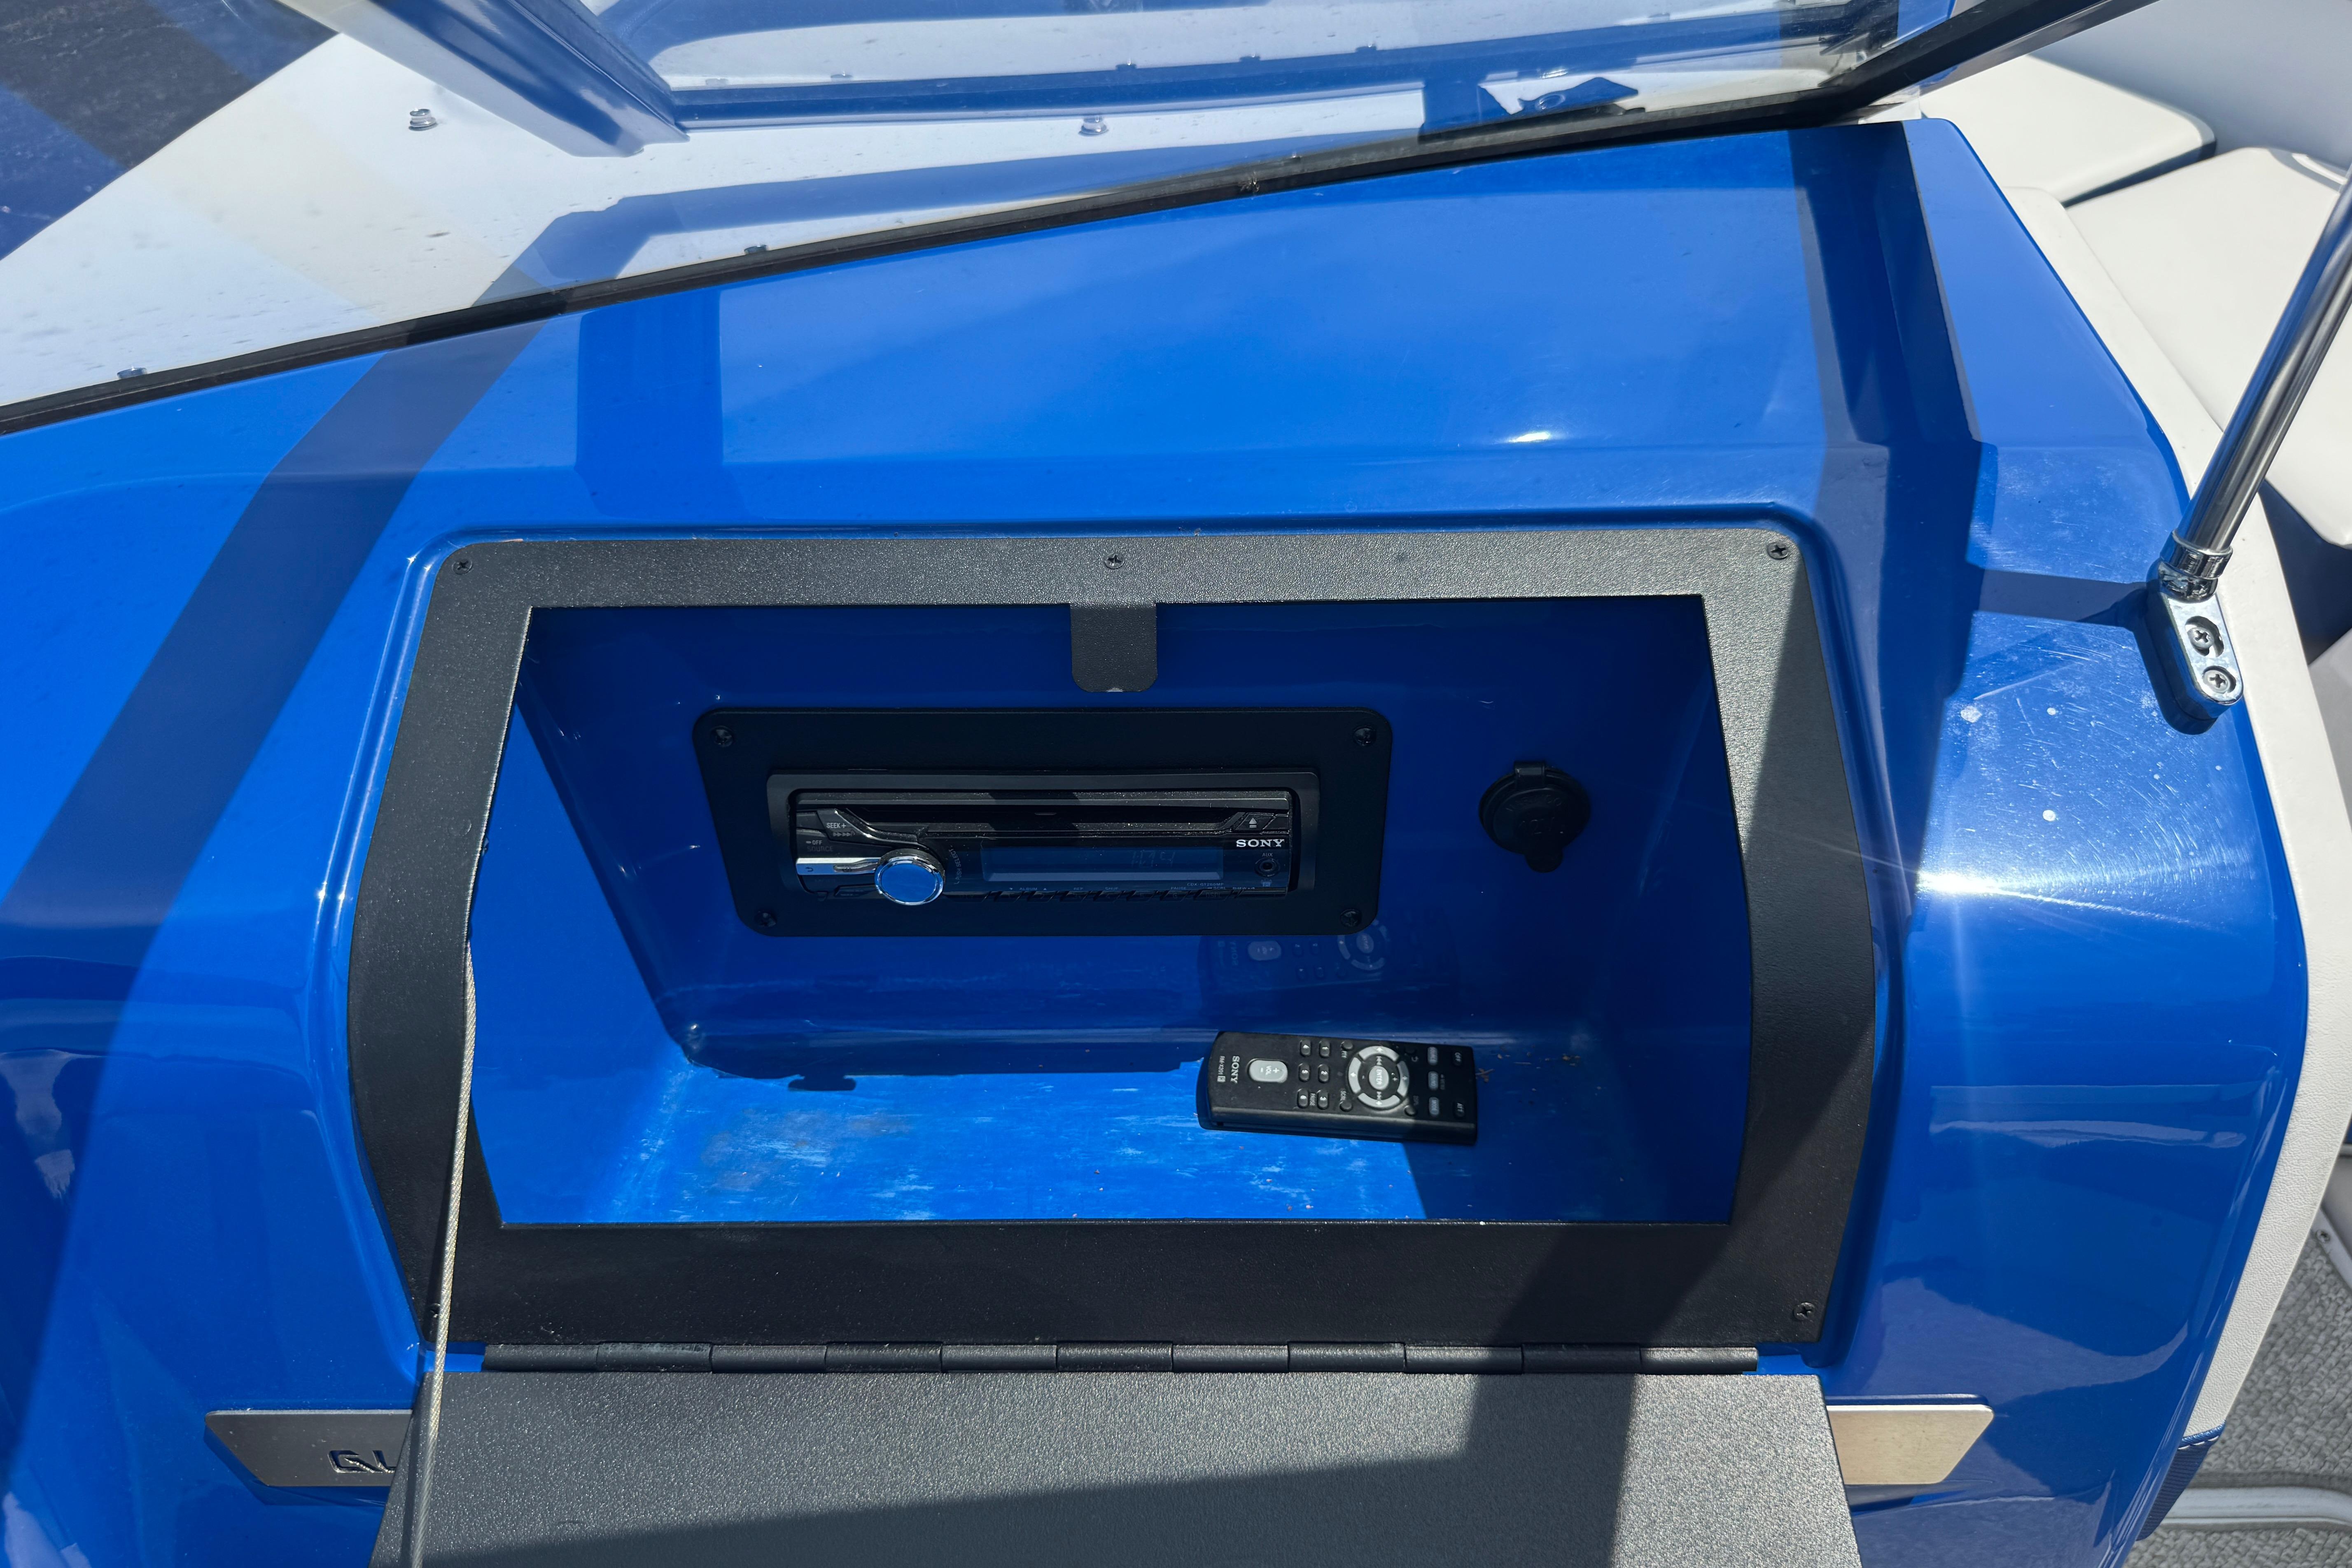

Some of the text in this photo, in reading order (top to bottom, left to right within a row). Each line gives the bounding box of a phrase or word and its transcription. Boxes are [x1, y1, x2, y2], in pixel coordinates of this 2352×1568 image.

[1235, 838, 1285, 848] SONY
[948, 849, 962, 867] SELECT
[1230, 1055, 1241, 1084] SONY
